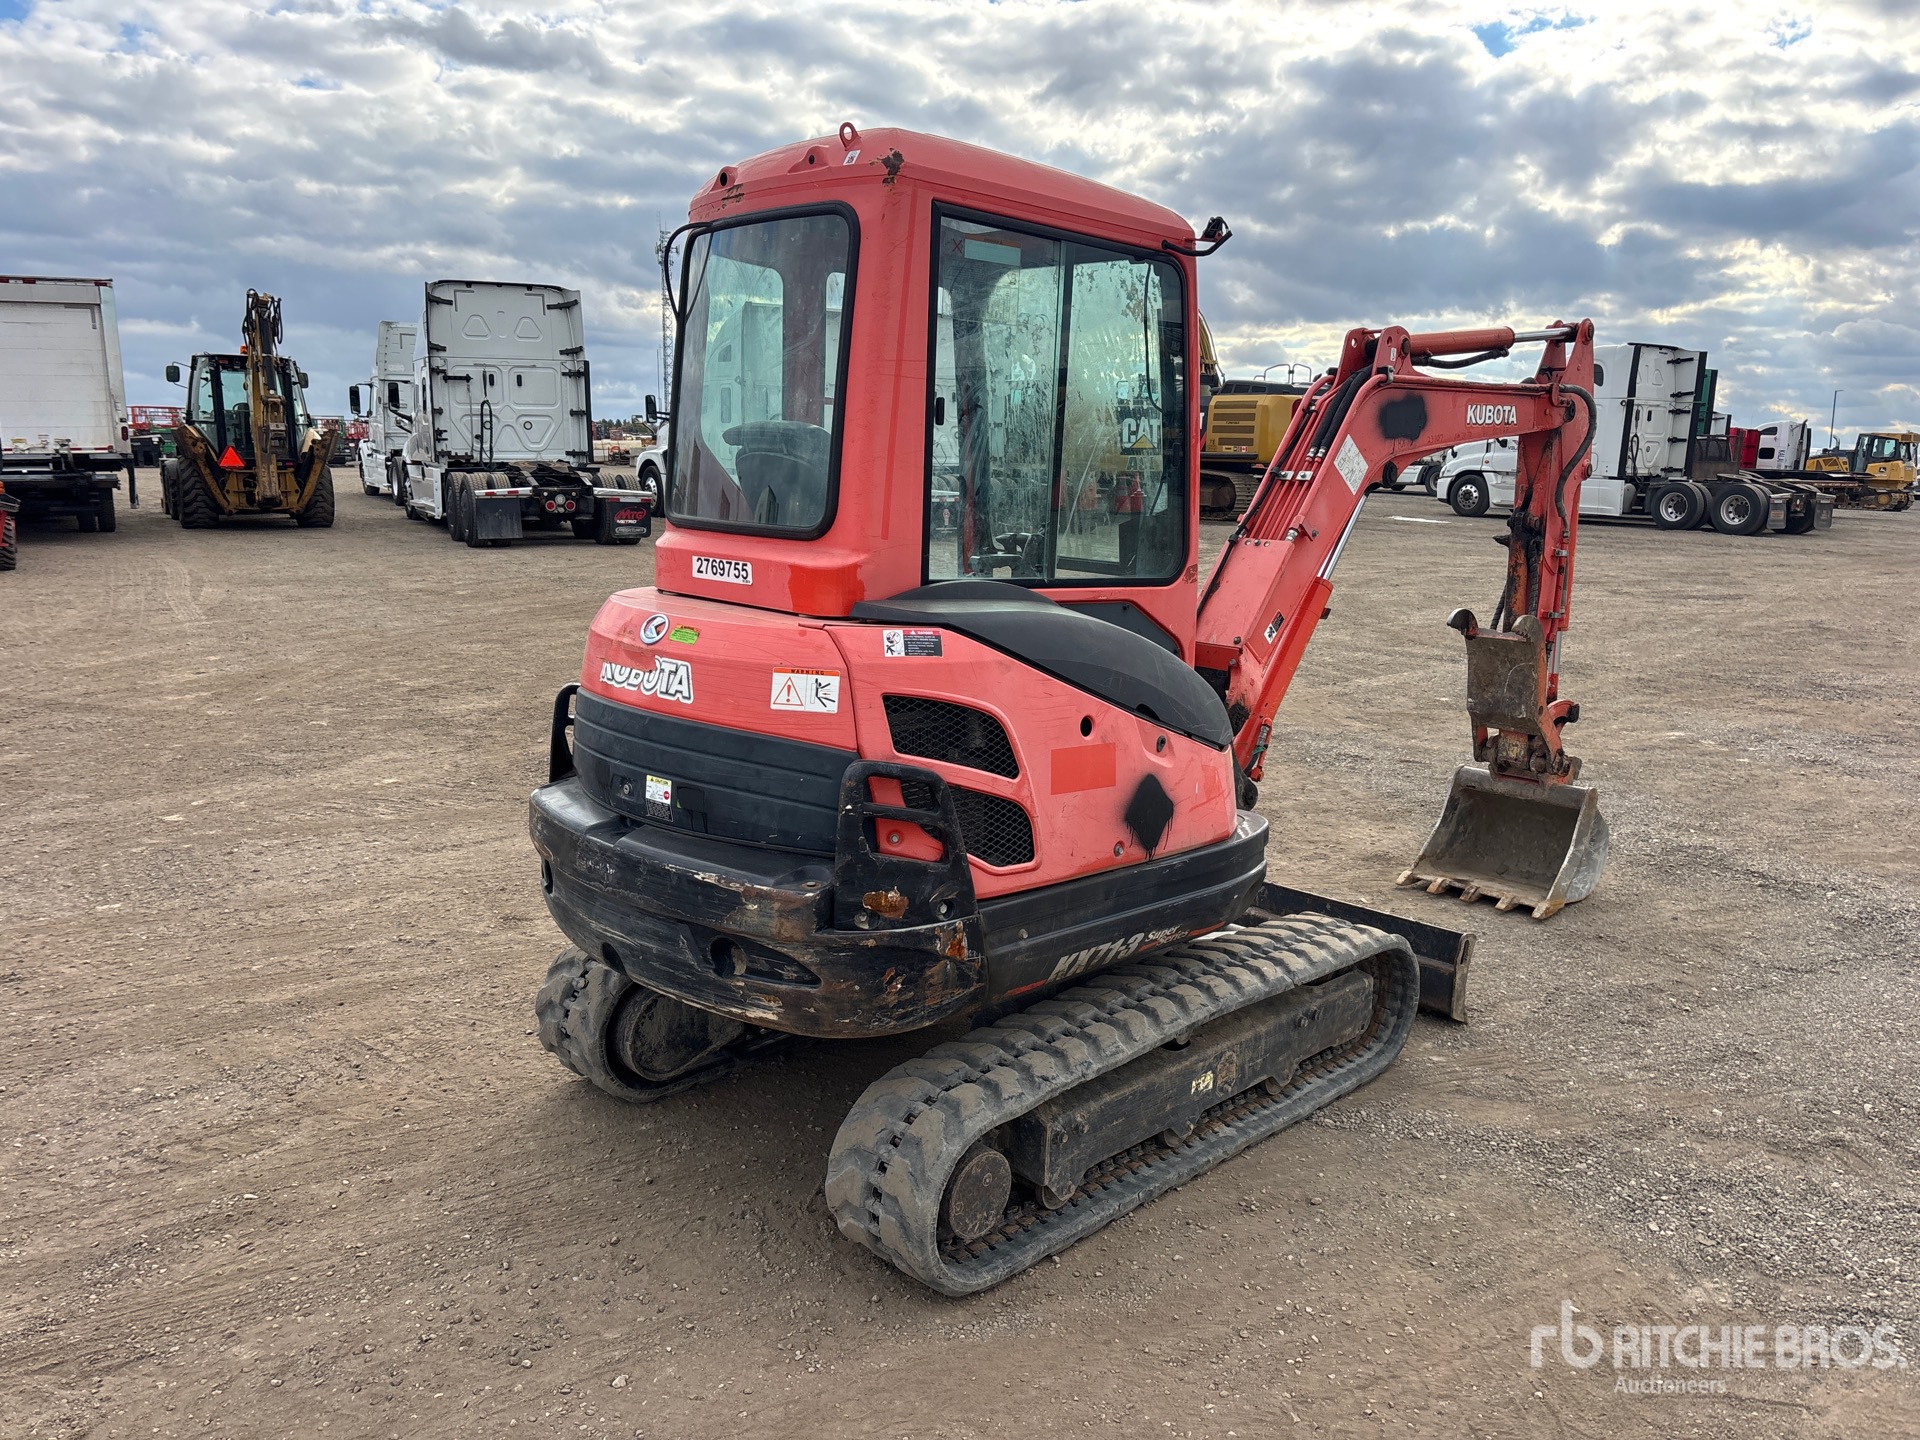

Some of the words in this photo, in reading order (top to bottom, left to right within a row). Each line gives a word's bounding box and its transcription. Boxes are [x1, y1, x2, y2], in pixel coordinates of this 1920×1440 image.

[1467, 404, 1517, 425] KUBOTA
[1122, 416, 1161, 449] CAT
[696, 557, 749, 580] 2769755
[790, 668, 825, 676] WARNING
[1146, 924, 1182, 942] Super
[1157, 930, 1190, 946] Series
